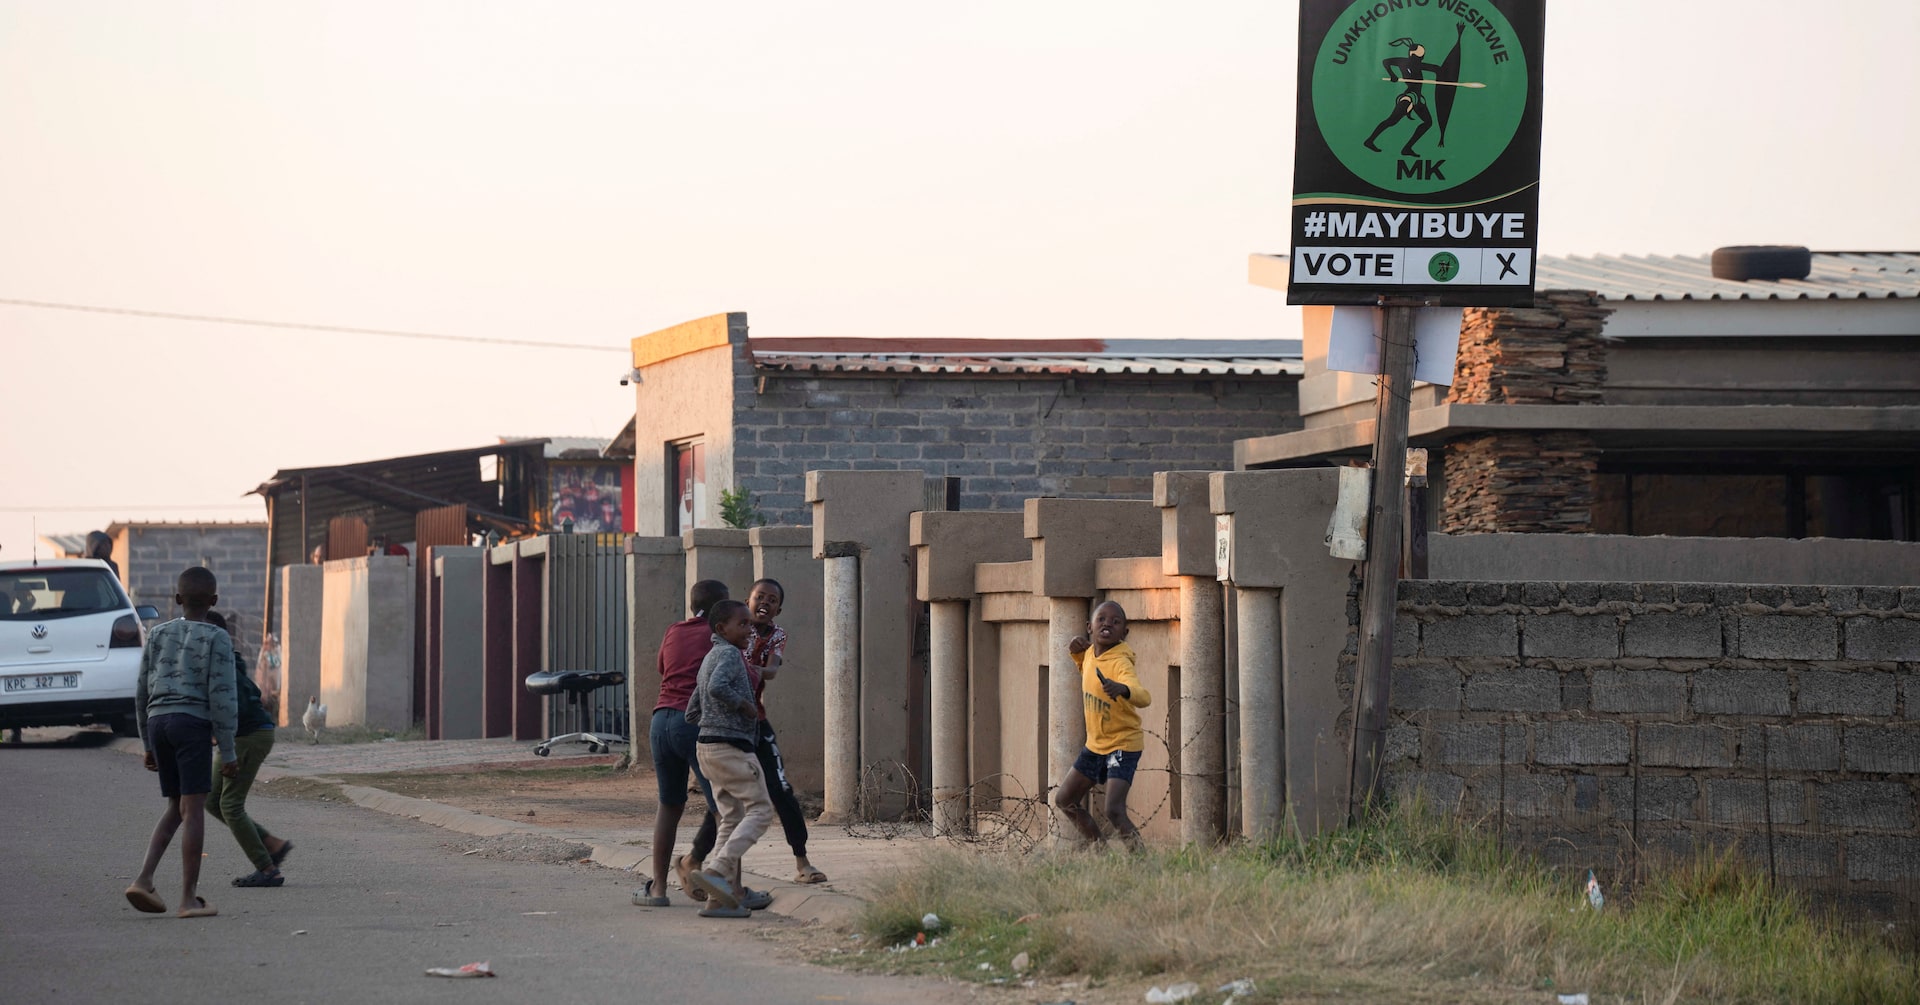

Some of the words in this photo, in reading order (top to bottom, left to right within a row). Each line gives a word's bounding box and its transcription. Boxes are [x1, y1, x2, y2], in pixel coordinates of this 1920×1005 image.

[1438, 0, 1509, 65] WESIZWE
[1396, 159, 1446, 181] MK
[1304, 211, 1525, 239] #MAYIBUYE
[1303, 252, 1394, 277] VOTE
